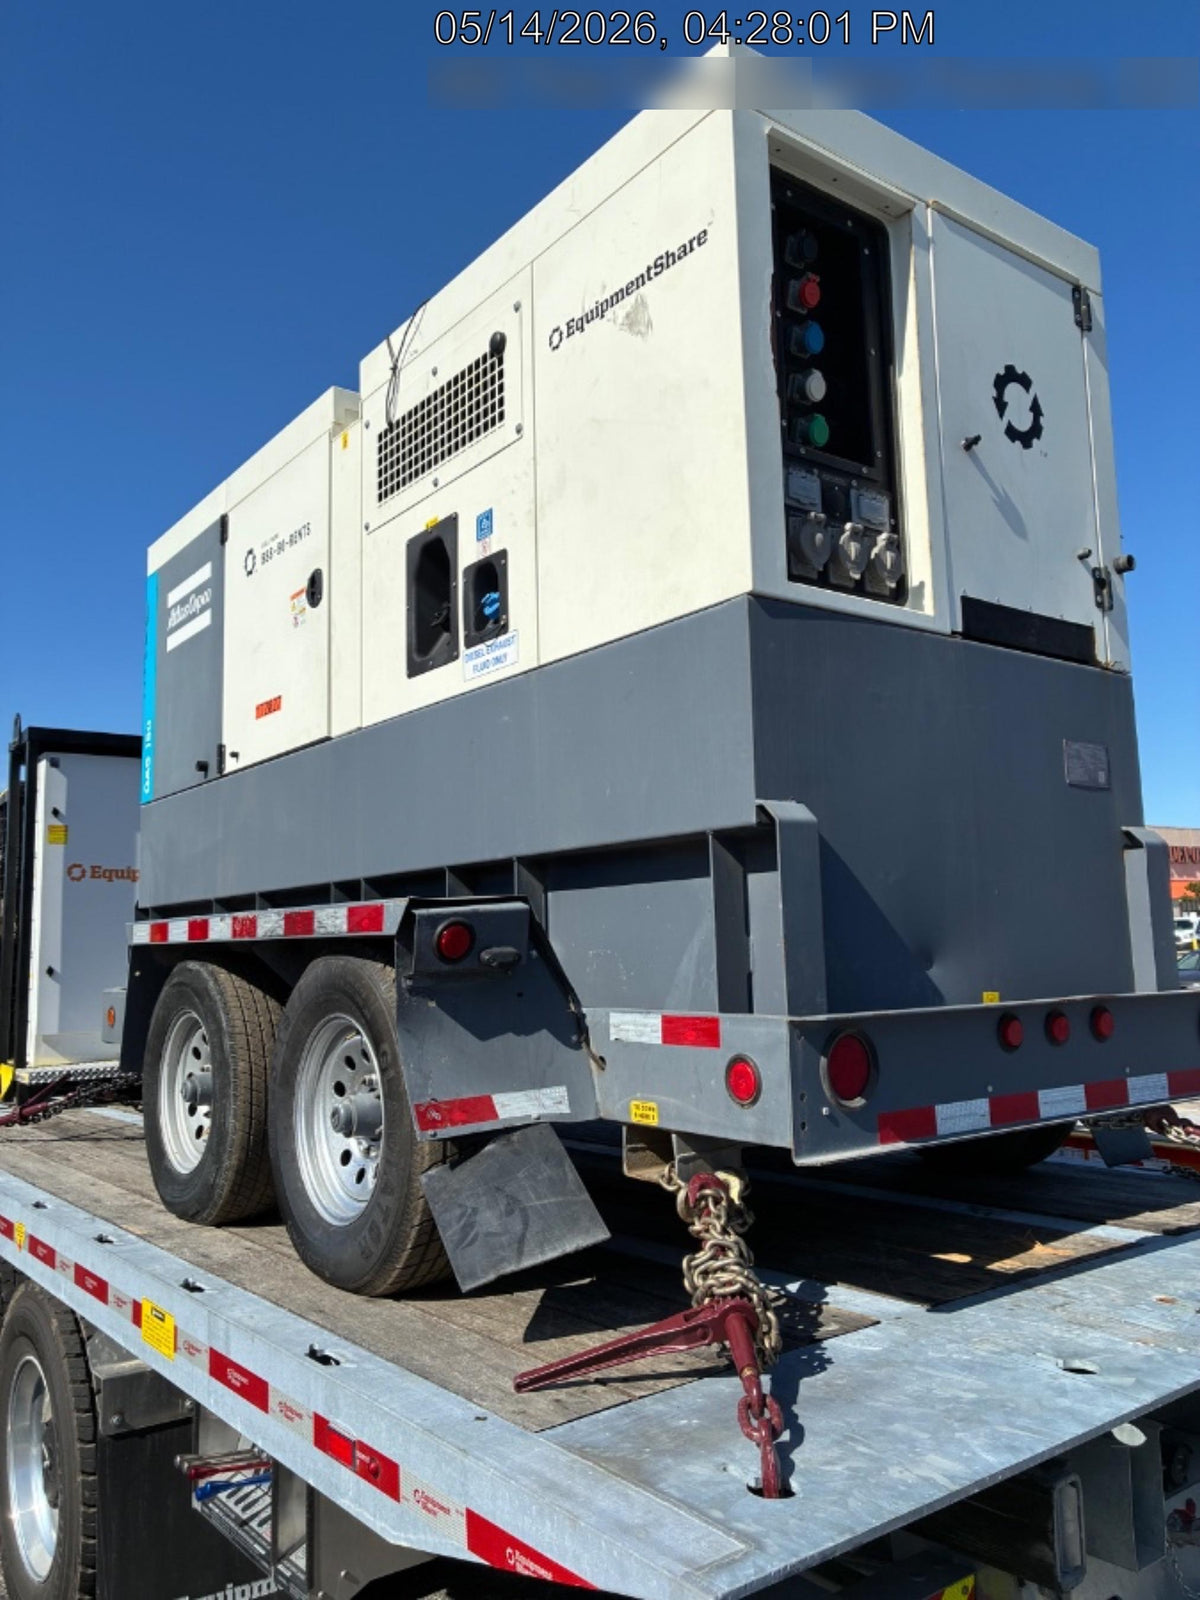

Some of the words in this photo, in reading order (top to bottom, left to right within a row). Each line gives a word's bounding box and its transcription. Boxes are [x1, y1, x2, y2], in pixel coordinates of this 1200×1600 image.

[565, 228, 708, 338] EquipmentShare
[89, 865, 139, 883] Equip
[174, 1578, 279, 1600] uipm
